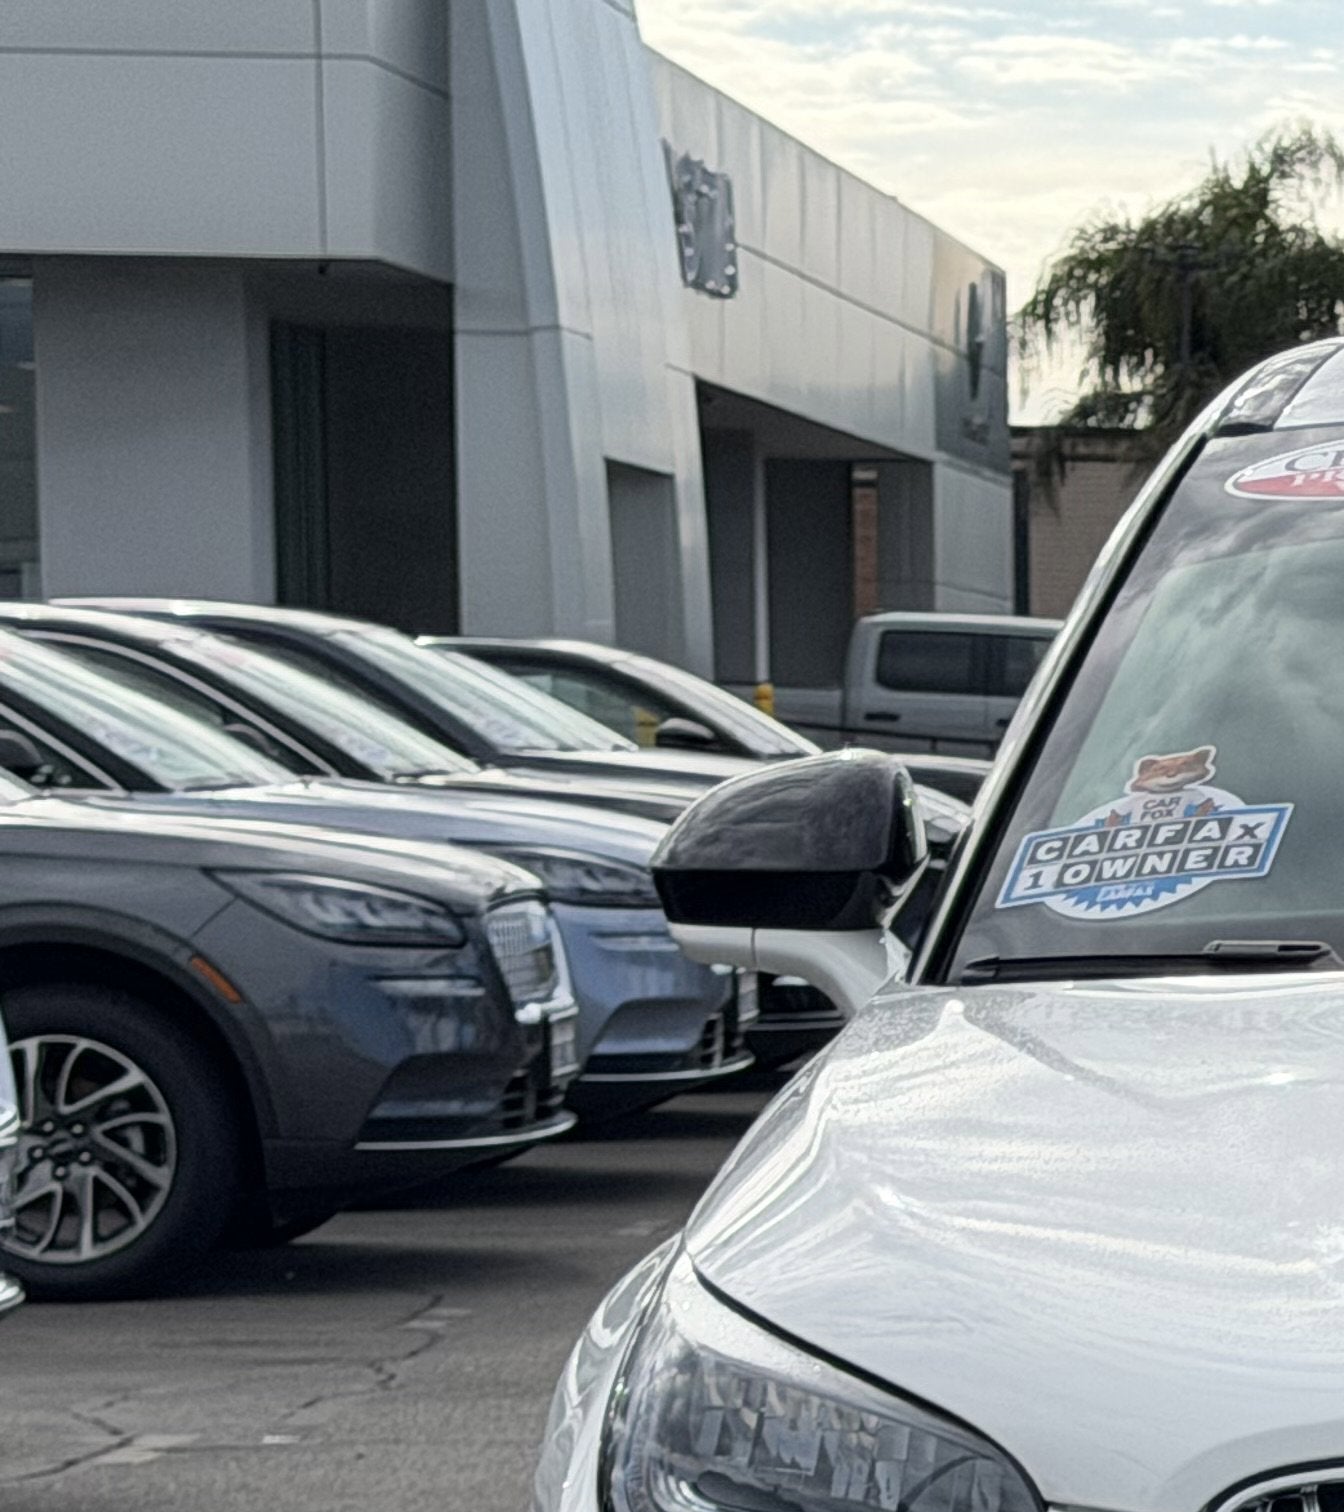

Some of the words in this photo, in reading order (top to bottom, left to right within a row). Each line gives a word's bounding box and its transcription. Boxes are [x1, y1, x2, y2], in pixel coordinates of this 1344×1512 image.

[1034, 818, 1268, 861] CARFAX
[1022, 871, 1045, 891] 1
[1062, 845, 1256, 886] OWNER
